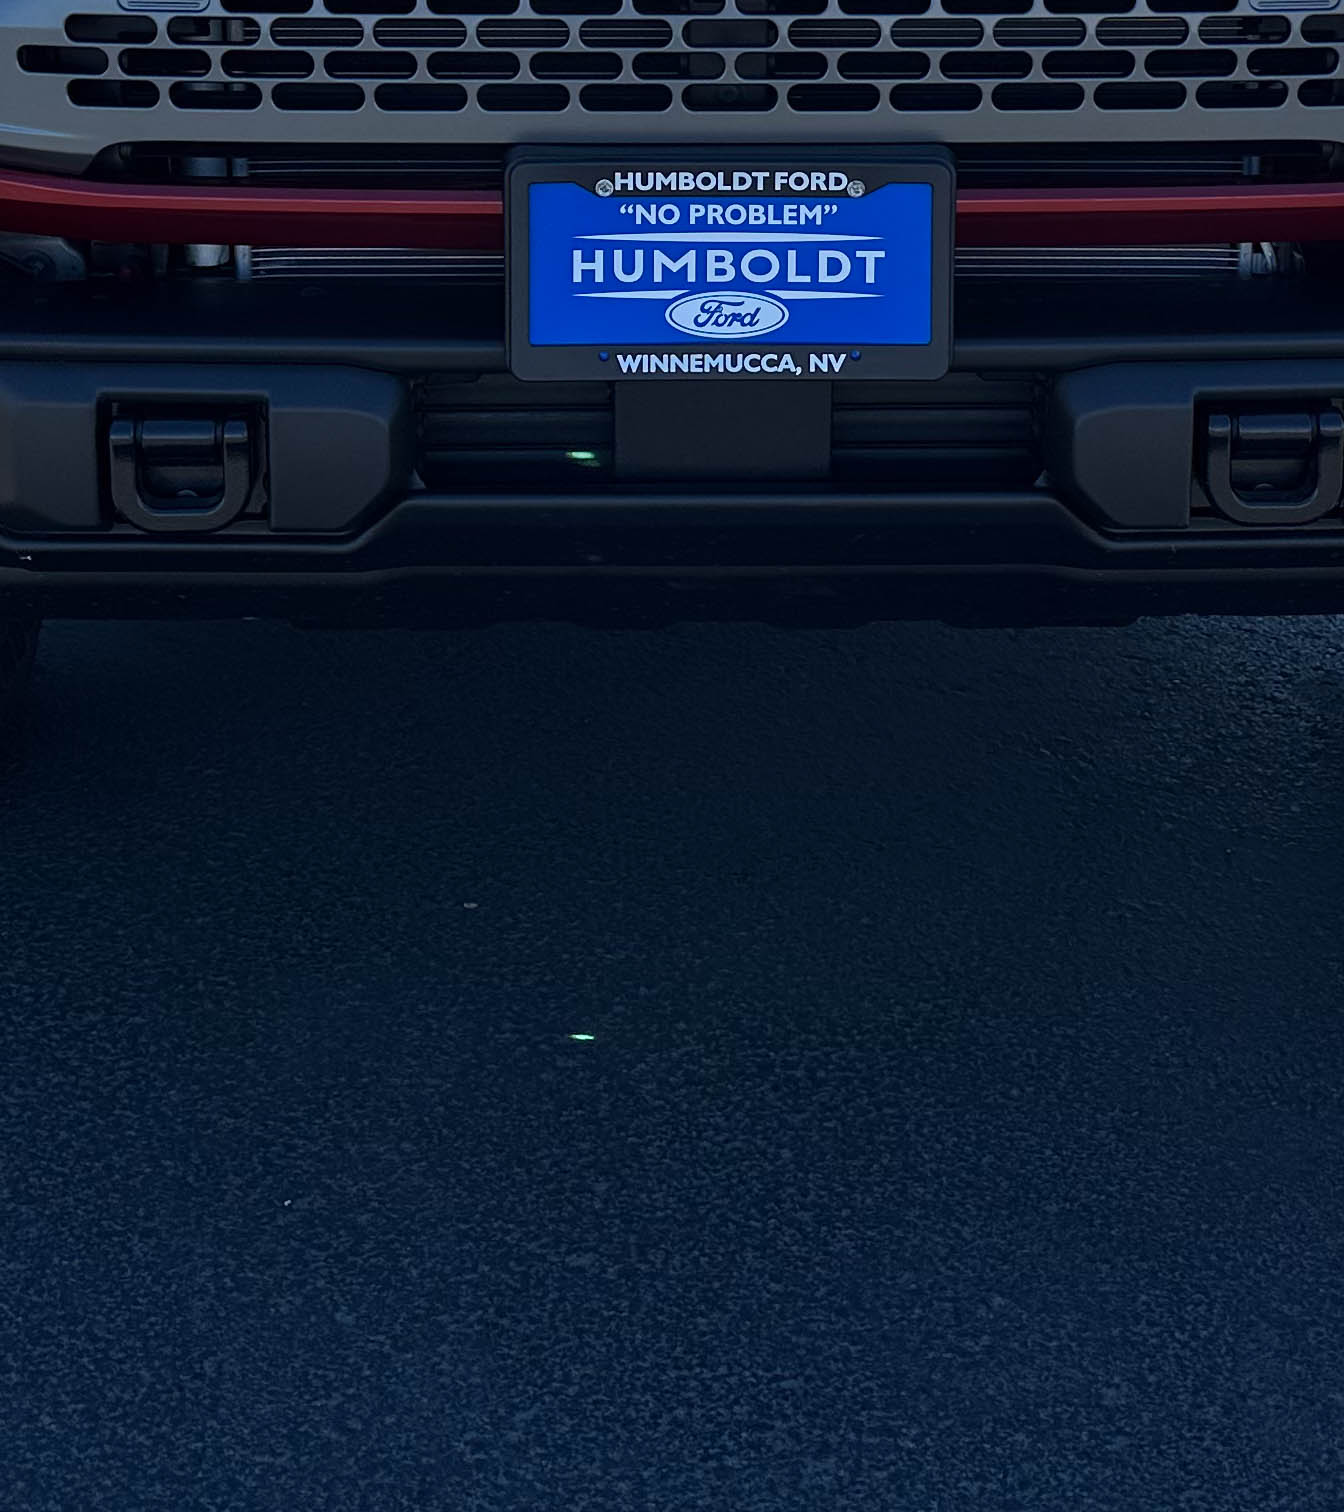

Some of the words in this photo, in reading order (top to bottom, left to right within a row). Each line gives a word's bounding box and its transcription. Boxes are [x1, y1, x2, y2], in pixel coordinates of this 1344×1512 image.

[614, 171, 770, 192] HUMBOLDT
[774, 171, 848, 192] FORD
[619, 203, 681, 225] “NO
[689, 203, 838, 225] PROBLEM”
[572, 249, 886, 284] HUMBOLDT
[693, 299, 761, 331] Ford
[616, 353, 803, 376] WINNEMUCCA,
[809, 353, 847, 373] NV
